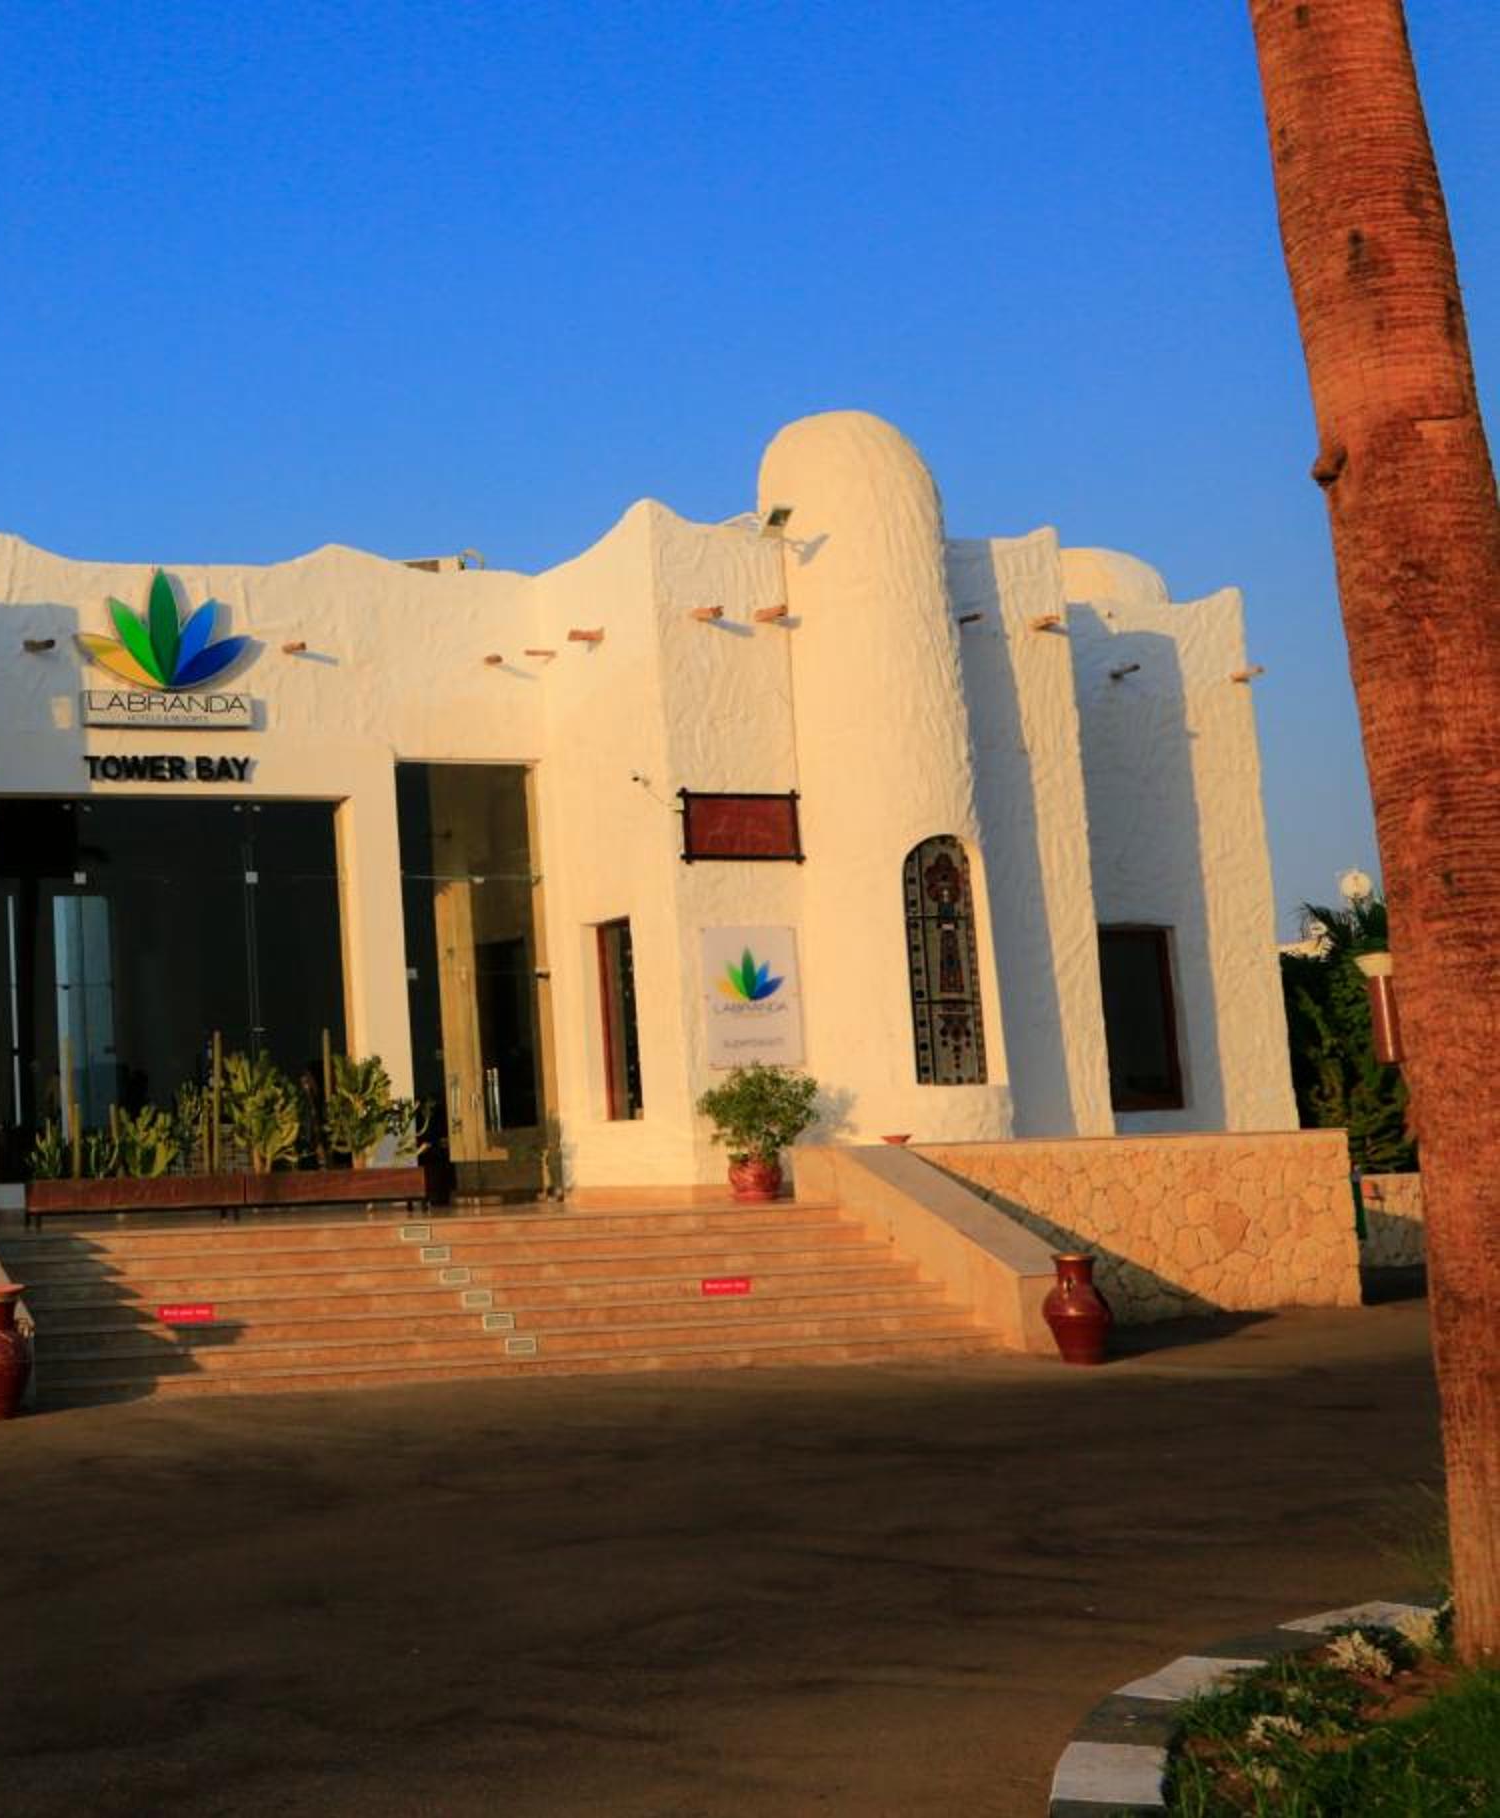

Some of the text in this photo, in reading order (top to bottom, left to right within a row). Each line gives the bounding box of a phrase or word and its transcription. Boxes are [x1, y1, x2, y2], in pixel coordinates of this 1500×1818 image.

[87, 692, 247, 714] LABRANDA
[84, 755, 250, 780] TOWER BAY
